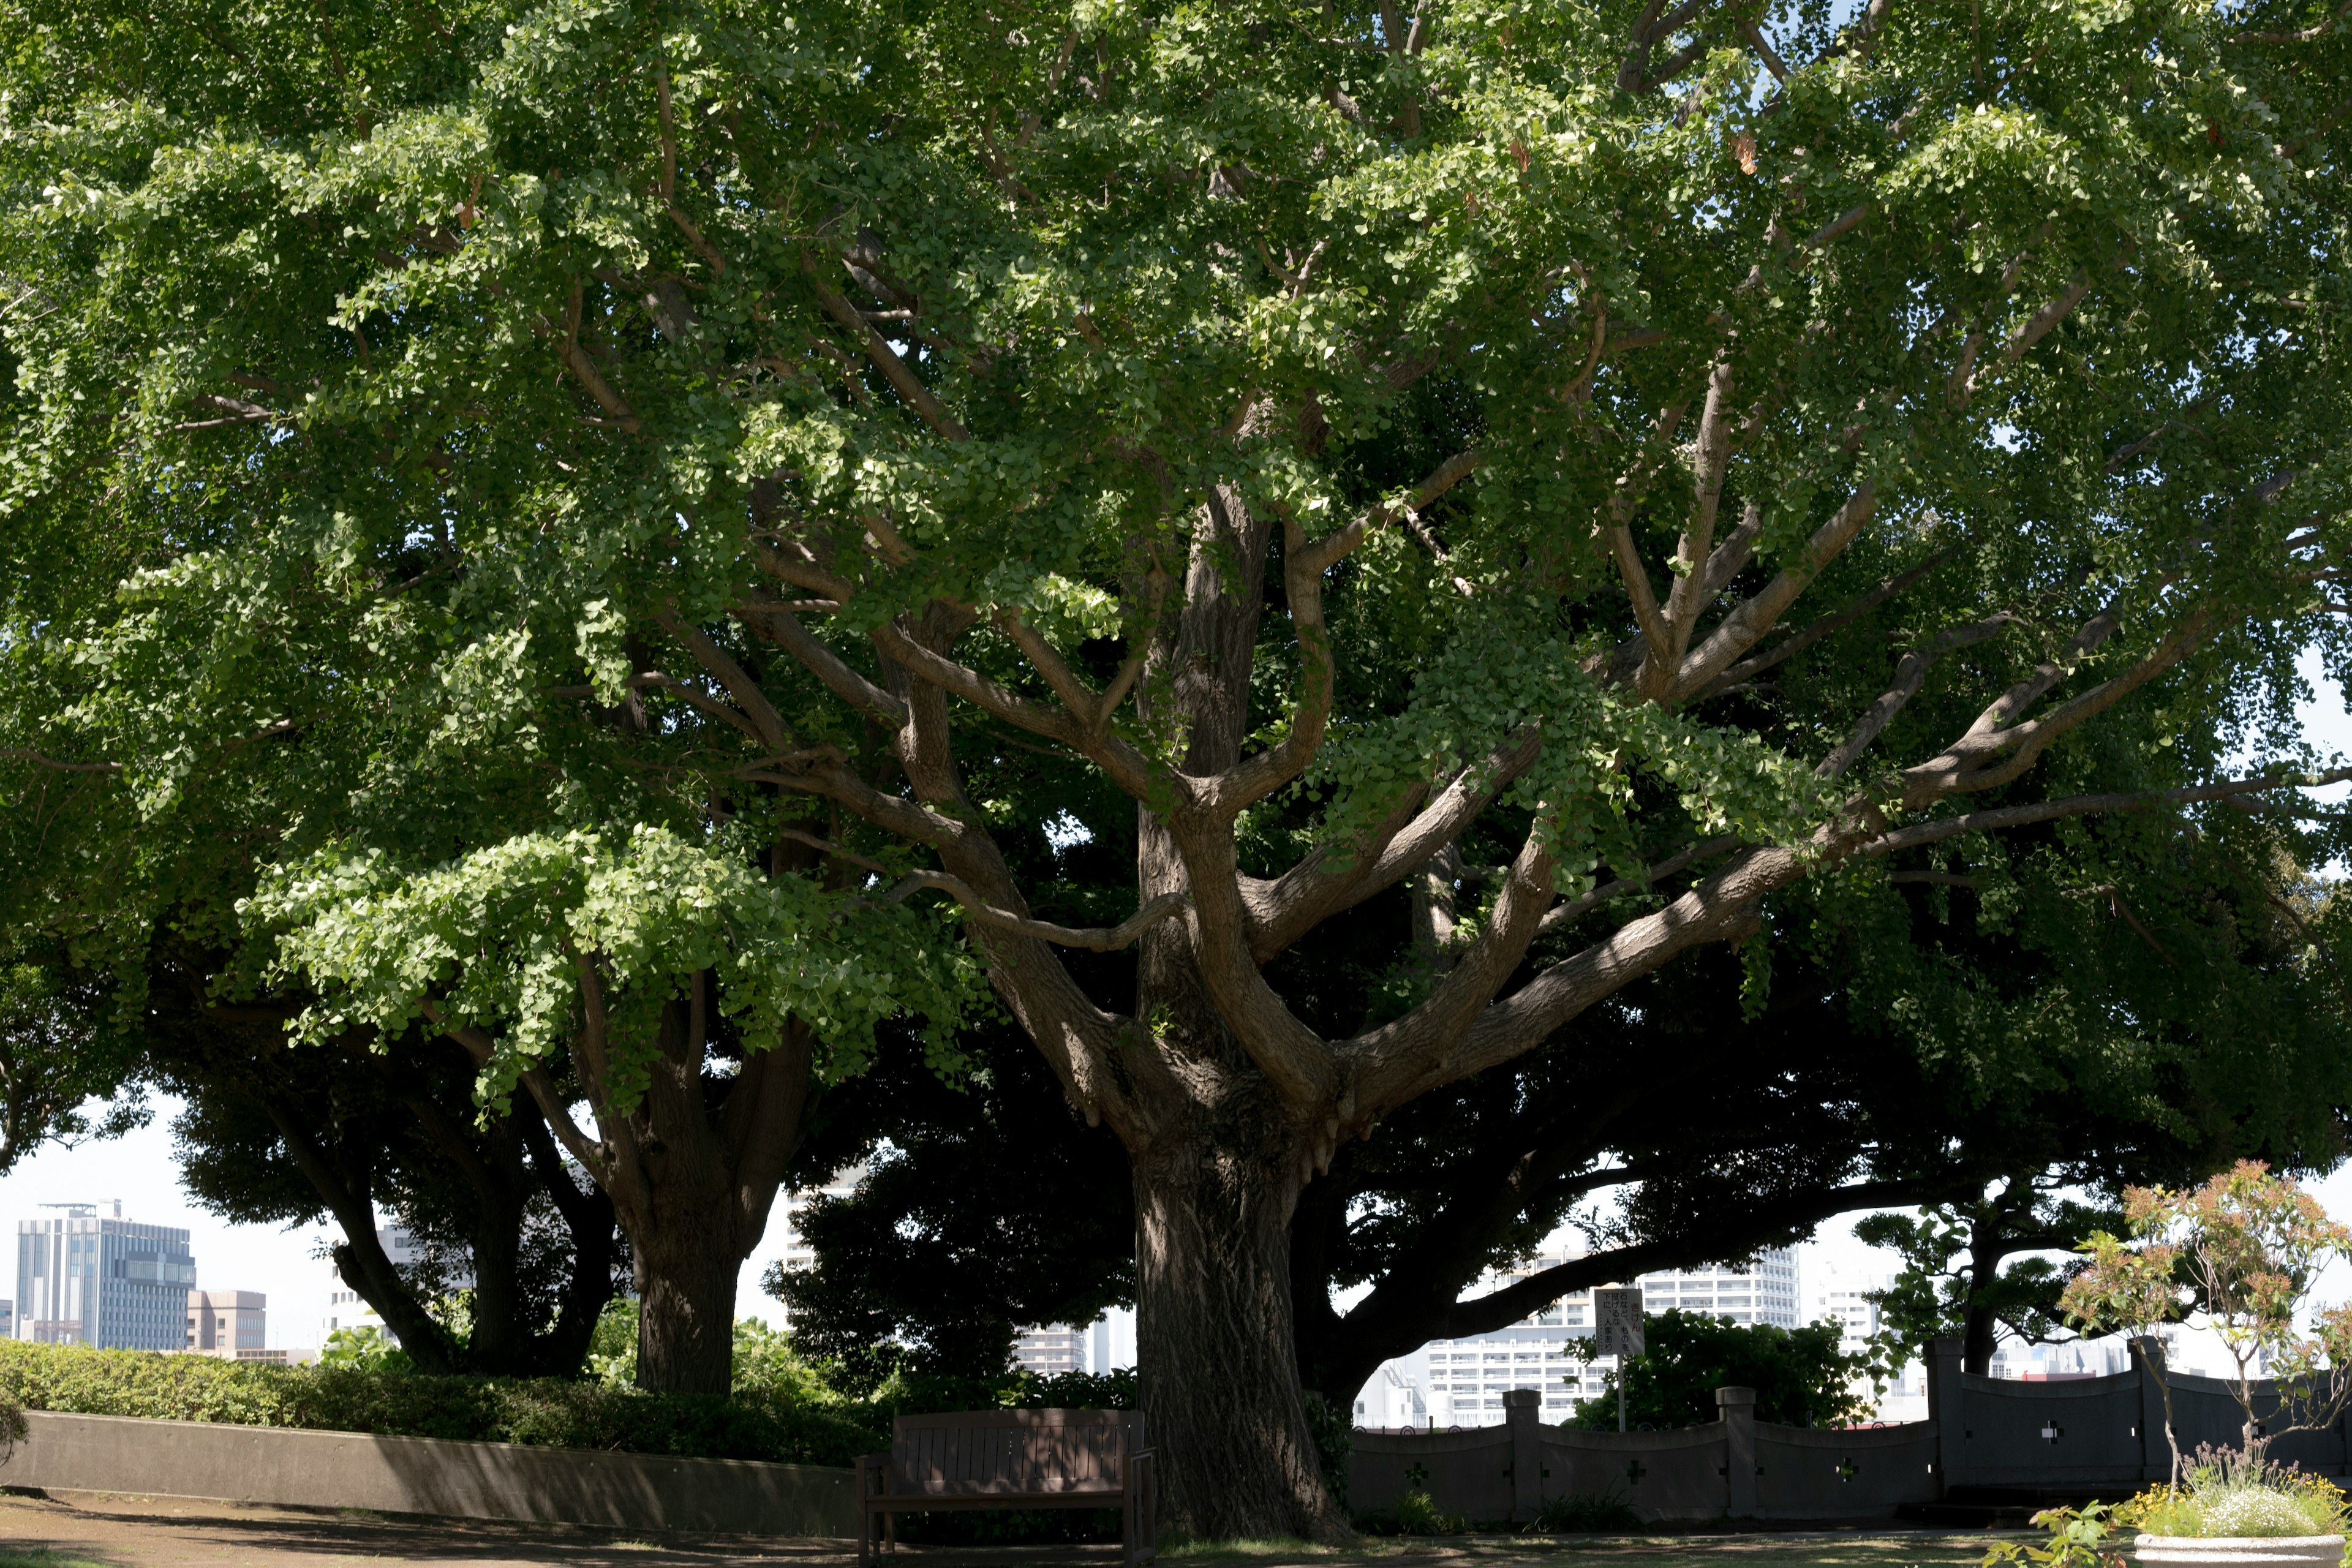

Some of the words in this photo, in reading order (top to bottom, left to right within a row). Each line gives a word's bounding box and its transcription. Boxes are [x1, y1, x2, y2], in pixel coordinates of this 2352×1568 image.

[1611, 1292, 1620, 1326] 投げるな
[1631, 1303, 1641, 1332] きけん
